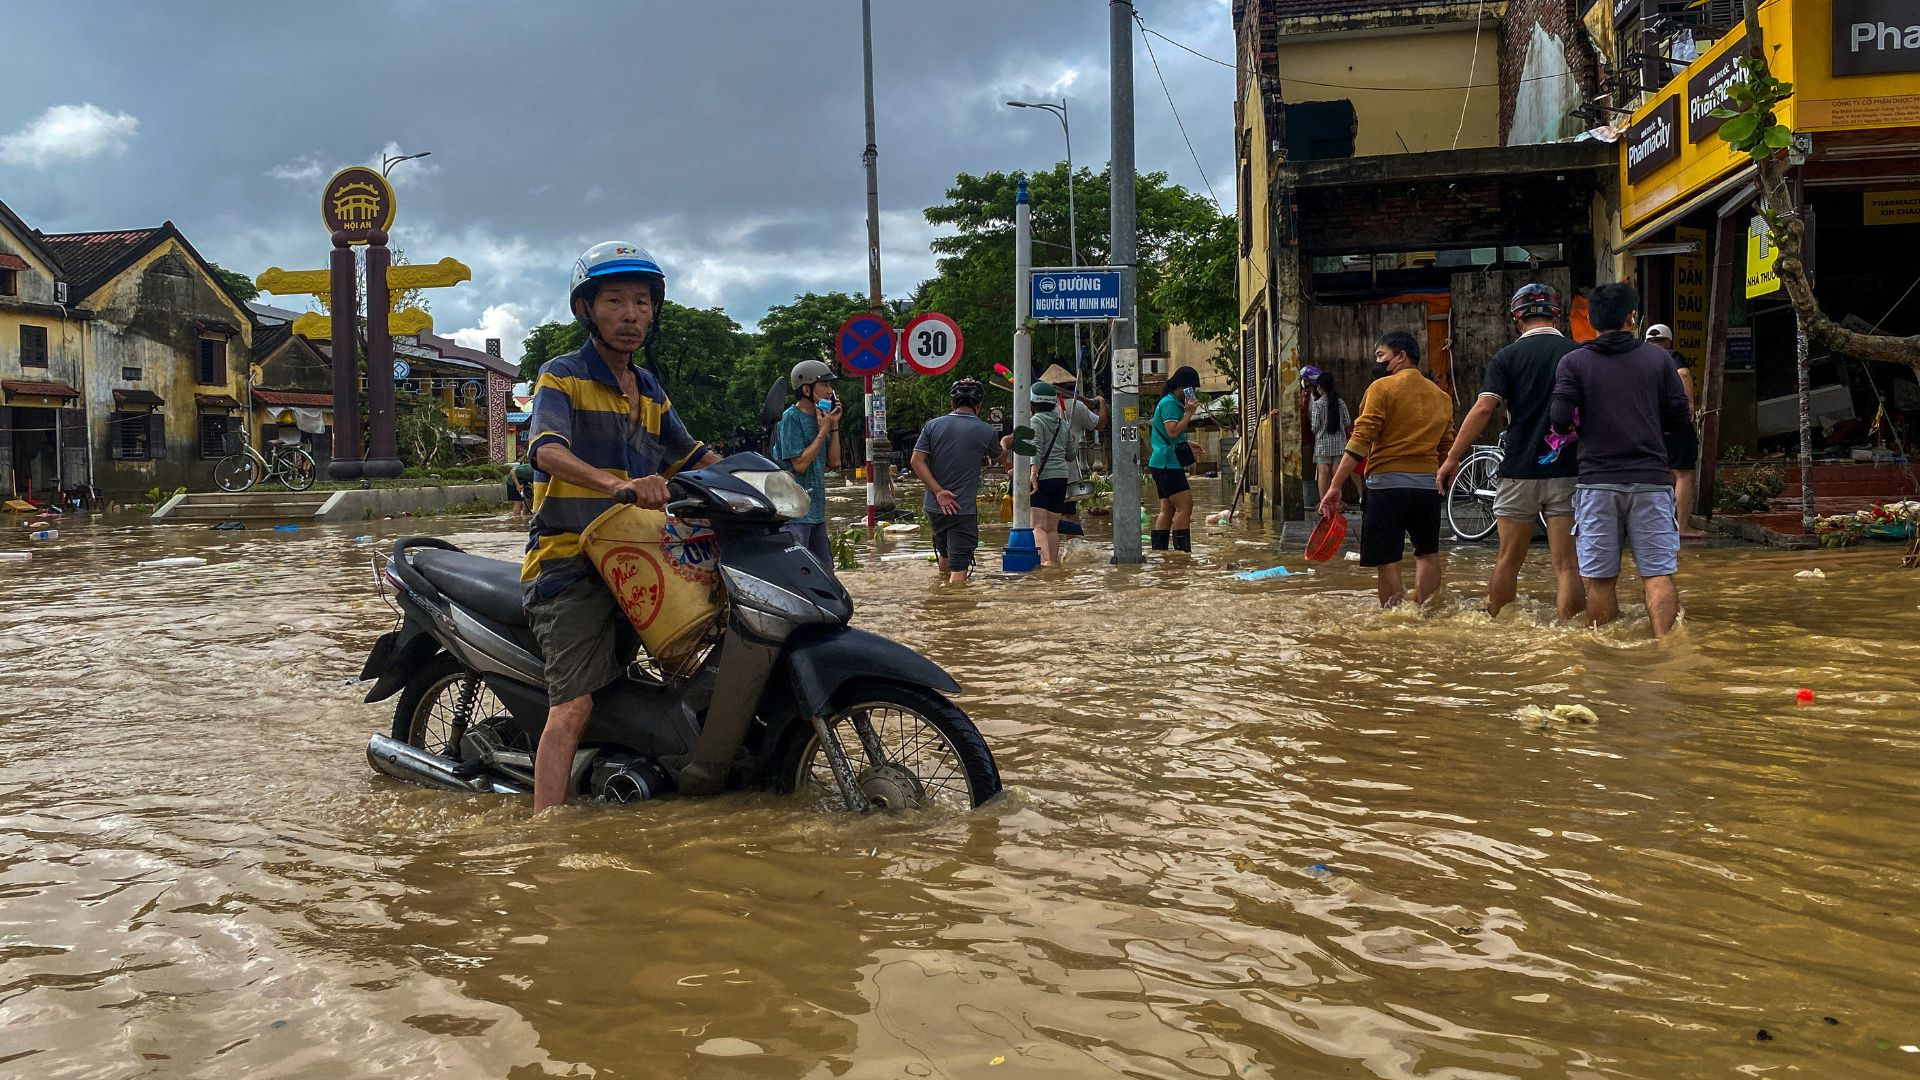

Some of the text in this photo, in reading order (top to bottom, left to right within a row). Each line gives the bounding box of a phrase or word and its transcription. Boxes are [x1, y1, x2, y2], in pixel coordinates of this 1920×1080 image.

[1628, 121, 1671, 169] Pharmacity
[343, 221, 372, 232] HỘI AN
[1058, 275, 1101, 292] ĐƯỜNG
[1036, 293, 1118, 313] NGUYỄN THỊ MINH KHAI
[1677, 320, 1703, 332] TRONG
[917, 331, 947, 357] 30
